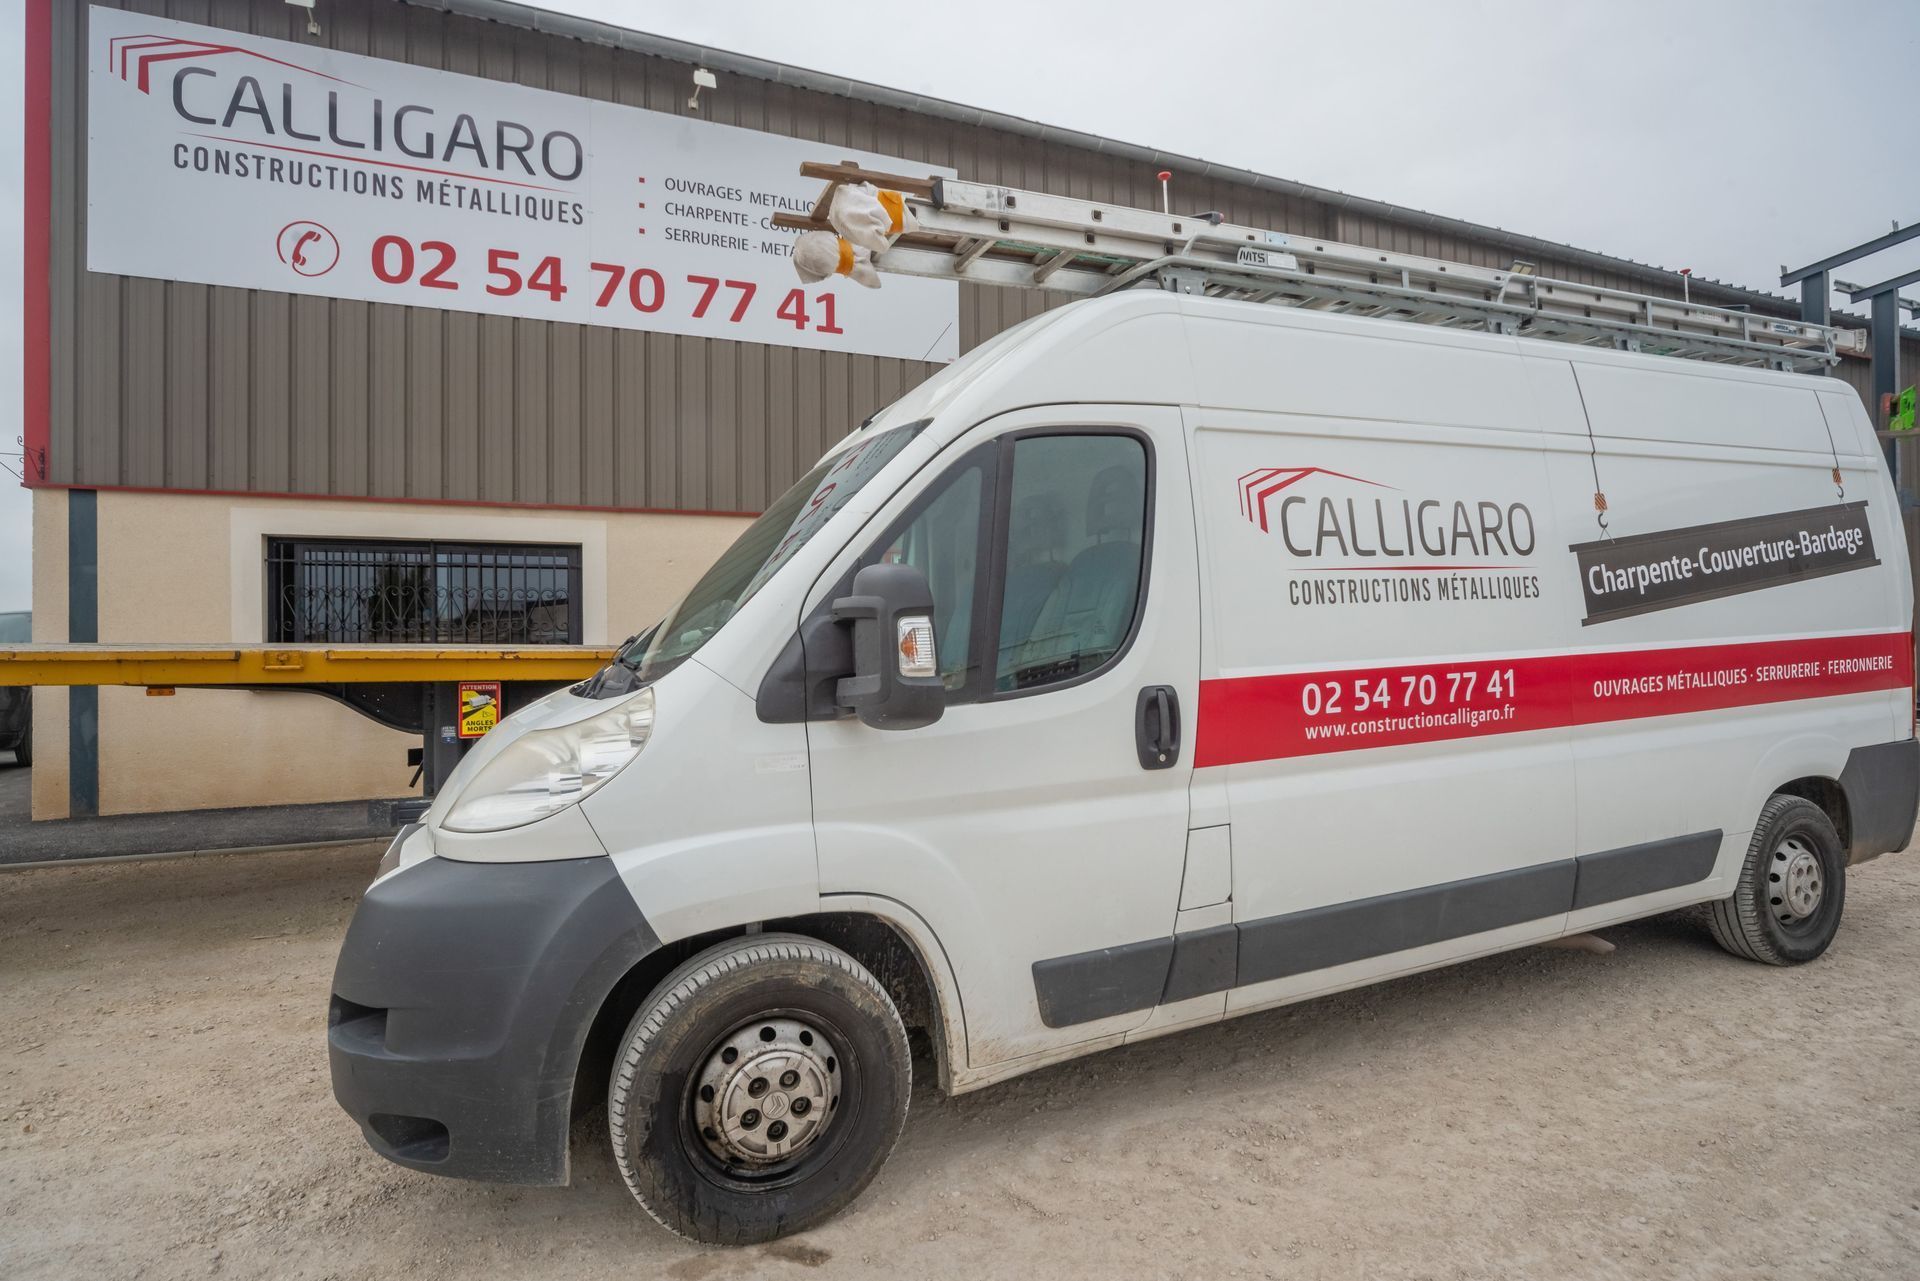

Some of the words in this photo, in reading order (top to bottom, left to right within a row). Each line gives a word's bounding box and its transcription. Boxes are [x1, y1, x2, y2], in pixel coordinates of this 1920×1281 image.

[171, 66, 583, 182] CALLIGARO
[173, 142, 404, 200] CONSTRUCTIONS
[416, 178, 583, 226] MÉTALLIQUES
[664, 177, 743, 202] OUVRAGES
[664, 202, 749, 227] CHARPENTE
[664, 226, 749, 251] SERRURERIE
[371, 235, 459, 291] 02
[485, 248, 568, 302] 54
[590, 262, 665, 313] 70
[686, 274, 757, 323] 77
[776, 288, 843, 335] 41
[1280, 496, 1535, 557] CALLIGARO
[1588, 525, 1863, 595] Charpente-Couverture-Bardage
[1289, 578, 1431, 605] CONSTRUCTIONS
[1438, 572, 1540, 601] MÉTALLIQUES
[1302, 682, 1342, 716] 02
[1354, 678, 1391, 712] 54
[1401, 674, 1437, 706] 70
[1447, 671, 1478, 702] 77
[1486, 669, 1515, 699] 41
[1593, 675, 1663, 698] OUVRAGES
[1667, 668, 1748, 691] MÉTALLIQUES
[1756, 661, 1820, 682] SERRURERIE
[1828, 655, 1893, 675] FERRONNERIE
[1305, 704, 1515, 740] www.constructioncalligaro.fr
